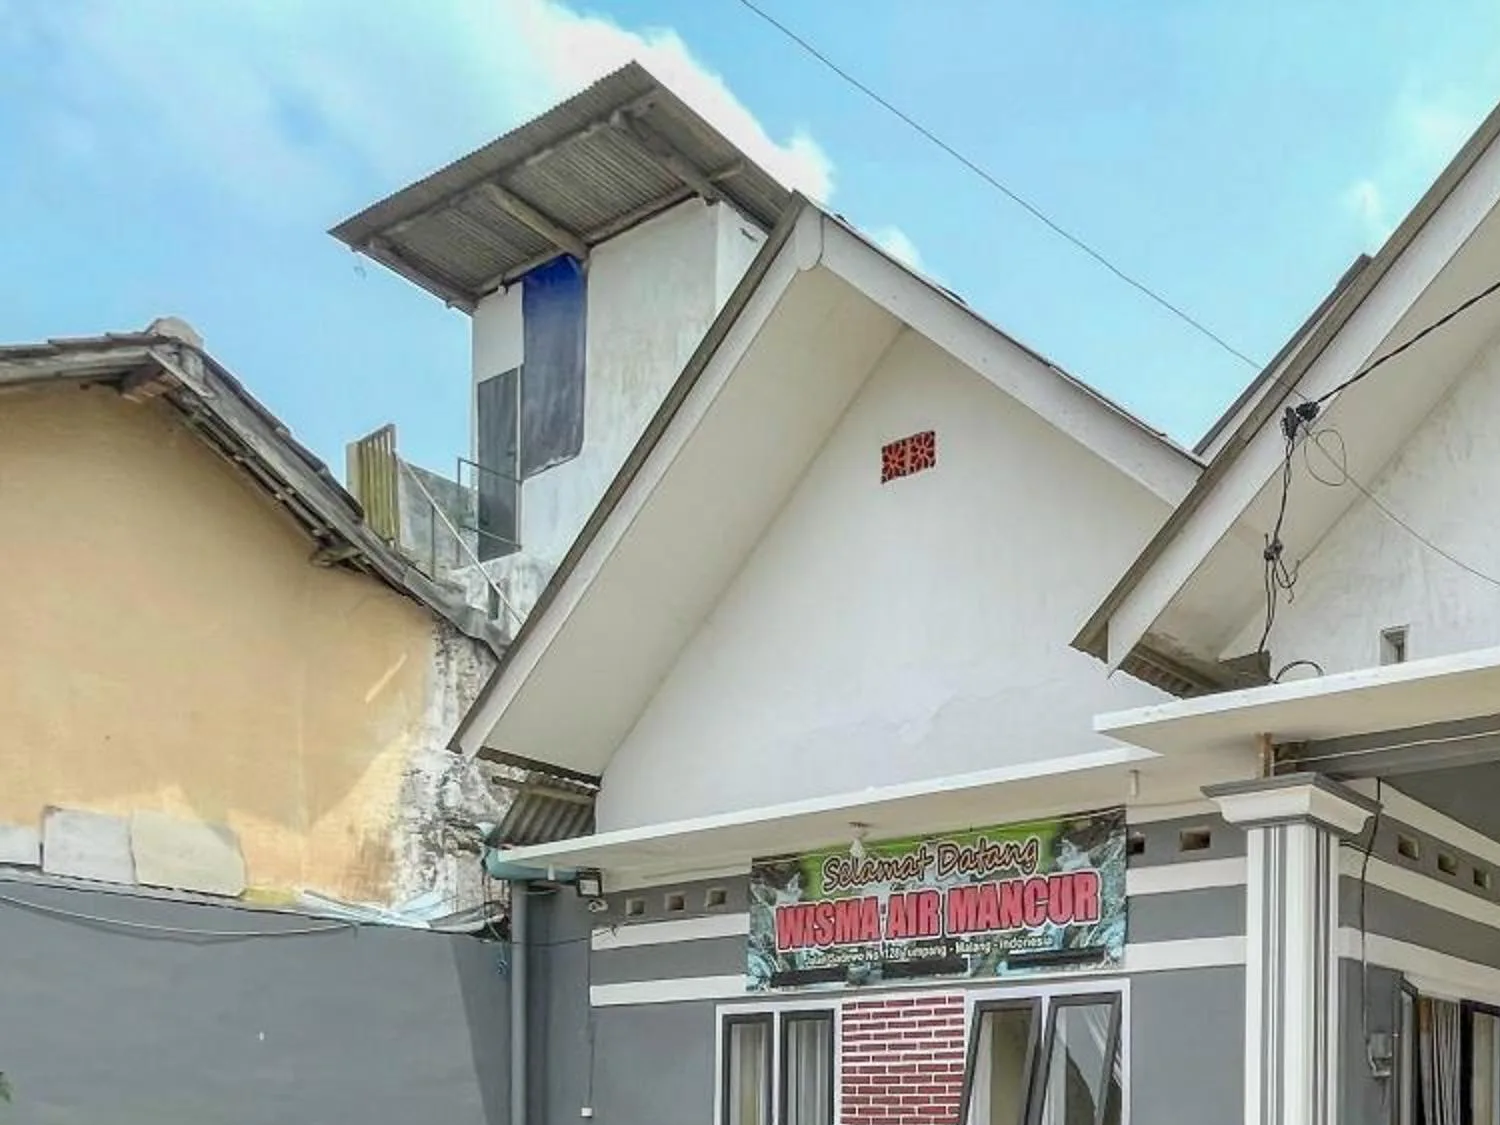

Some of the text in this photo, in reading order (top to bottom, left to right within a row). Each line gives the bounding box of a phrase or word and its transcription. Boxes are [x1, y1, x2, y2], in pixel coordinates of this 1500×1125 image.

[823, 836, 1040, 892] Selamat Datang
[776, 871, 1101, 951] WISMA AIR MANCUR
